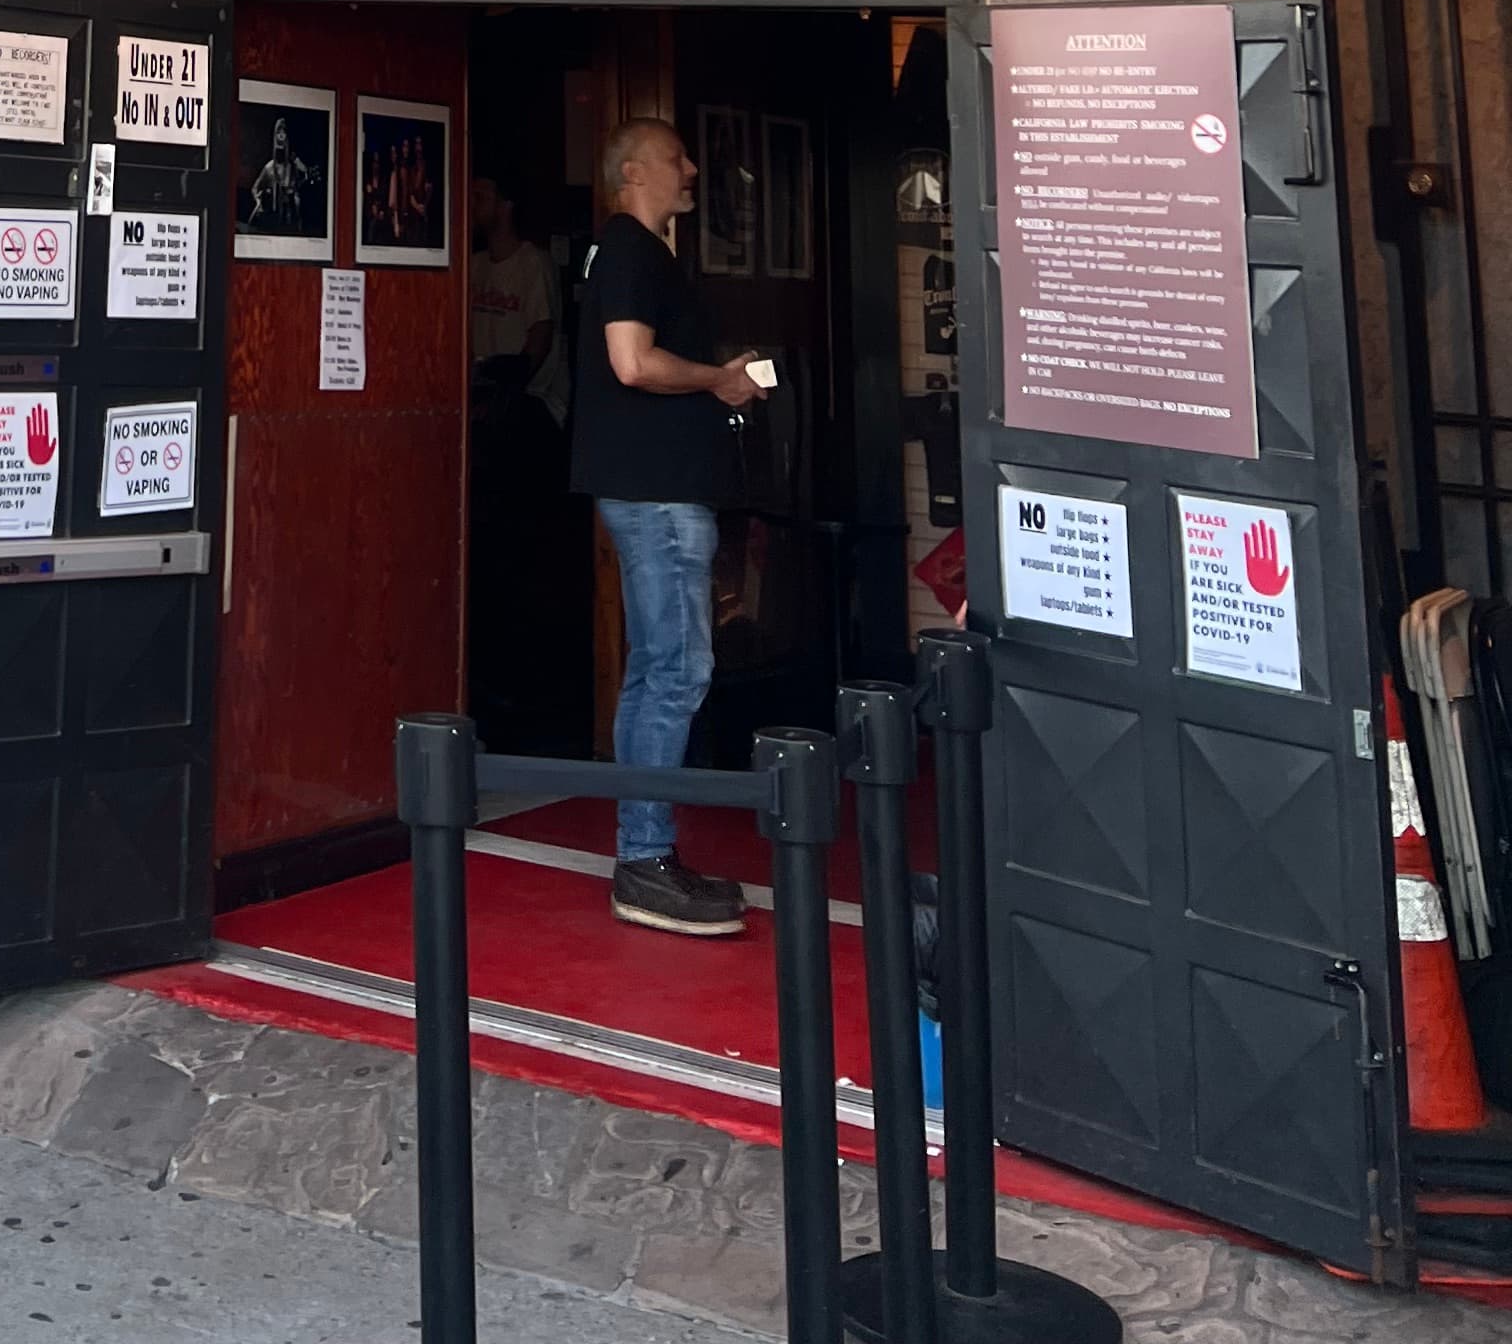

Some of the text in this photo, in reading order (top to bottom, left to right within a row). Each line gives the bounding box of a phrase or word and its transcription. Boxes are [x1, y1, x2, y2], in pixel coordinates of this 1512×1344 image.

[1065, 33, 1147, 51] ATTENTION
[130, 43, 197, 83] UNDER 21
[144, 93, 159, 127] IN
[163, 105, 171, 128] &
[175, 96, 204, 130] OUT
[1140, 120, 1185, 131] SMOKING
[123, 220, 145, 243] NO
[12, 267, 65, 283] SMOKING
[16, 285, 59, 300] VAPING
[113, 419, 189, 440] NO SMOKING
[6, 460, 25, 470] SICK
[140, 450, 158, 466] OR
[23, 472, 51, 483] TESTED
[25, 485, 42, 496] FOR
[126, 477, 170, 496] VAPING
[1019, 501, 1046, 530] NO
[1185, 511, 1228, 528] PLEASE
[1187, 527, 1215, 542] STAY
[1188, 543, 1224, 559] AWAY
[1190, 559, 1228, 576] IF YOU
[1191, 575, 1244, 594] ARE SICK
[1191, 591, 1286, 618] AND/OR TESTED
[1192, 608, 1273, 633] POSITIVE FOR
[1193, 624, 1251, 645] COVID-19
